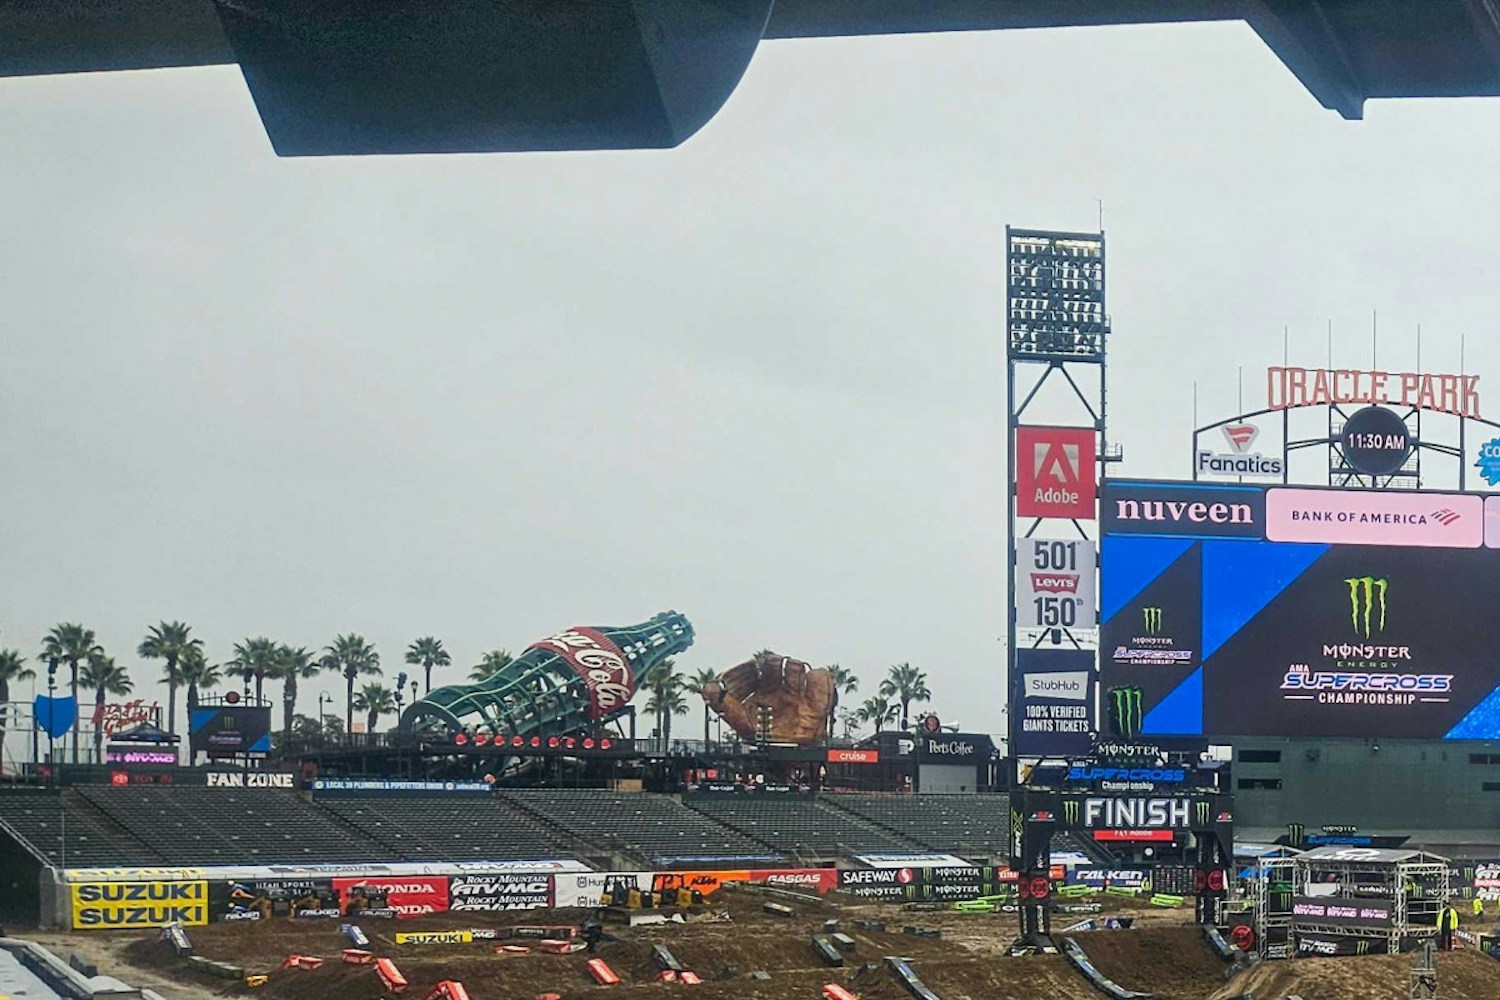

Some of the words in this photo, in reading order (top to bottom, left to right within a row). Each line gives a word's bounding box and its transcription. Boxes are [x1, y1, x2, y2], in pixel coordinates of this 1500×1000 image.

[1267, 367, 1388, 410] ORACLE
[1400, 373, 1482, 420] PARK
[1350, 433, 1382, 449] 11:30
[1385, 435, 1404, 450] AM
[1200, 453, 1281, 474] Fanatics
[1034, 488, 1079, 504] Adobe
[1116, 499, 1253, 524] nuveen
[1292, 510, 1333, 522] BANK
[1337, 511, 1356, 523] OF
[1360, 512, 1427, 525] AMERICA
[1034, 541, 1076, 570] 501
[1322, 643, 1412, 660] MONSTER
[1289, 664, 1310, 674] AMA
[1032, 680, 1079, 691] StubHub
[1280, 671, 1454, 693] SUPERCROSS
[1318, 692, 1416, 705] CHAMPIONSHIP
[1025, 705, 1049, 719] 100%
[1050, 706, 1086, 719] VERIFIED
[1022, 719, 1053, 732] GIANTS
[1055, 720, 1089, 733] TICKETS
[949, 741, 974, 756] Coffee
[839, 752, 867, 761] cruise
[206, 773, 243, 787] FAN
[247, 773, 294, 788] ZONE
[1102, 781, 1154, 791] Championship
[1085, 798, 1190, 827] FINISH
[843, 870, 897, 883] SAFEWAY
[935, 867, 980, 877] MONSTER
[1077, 871, 1144, 879] FALKEN
[466, 875, 495, 884] ROCKY
[498, 874, 548, 884] MOUNTAIN
[690, 877, 717, 886] KTM
[767, 875, 821, 884] GASGAS
[78, 884, 202, 901] SUZUKI
[855, 886, 902, 896] MONSTER
[935, 884, 980, 894] MONSTER
[466, 896, 495, 904] ROCKY
[498, 895, 548, 904] MOUNTAIN
[78, 906, 202, 924] SUZUKI
[300, 908, 340, 917] FALKEN
[406, 934, 464, 944] SUZUKI
